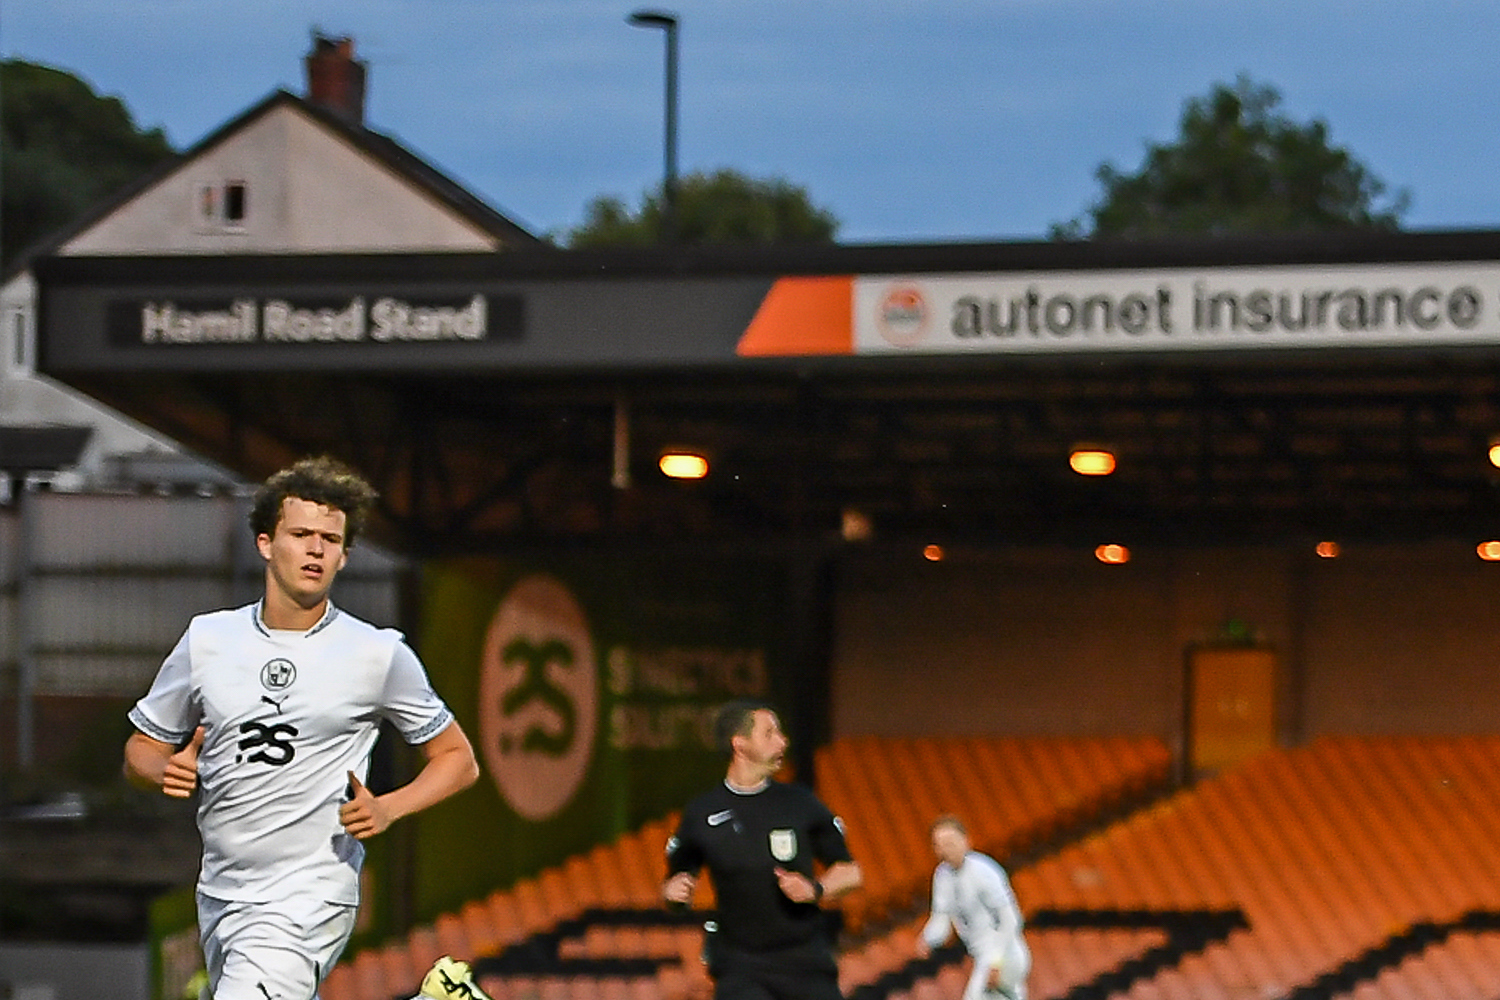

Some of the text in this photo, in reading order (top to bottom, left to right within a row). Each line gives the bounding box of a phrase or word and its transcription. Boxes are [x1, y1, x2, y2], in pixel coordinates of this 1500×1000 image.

[142, 293, 487, 343] Hamil Road Stand
[951, 281, 1174, 338] autonet
[1192, 276, 1483, 334] insurance
